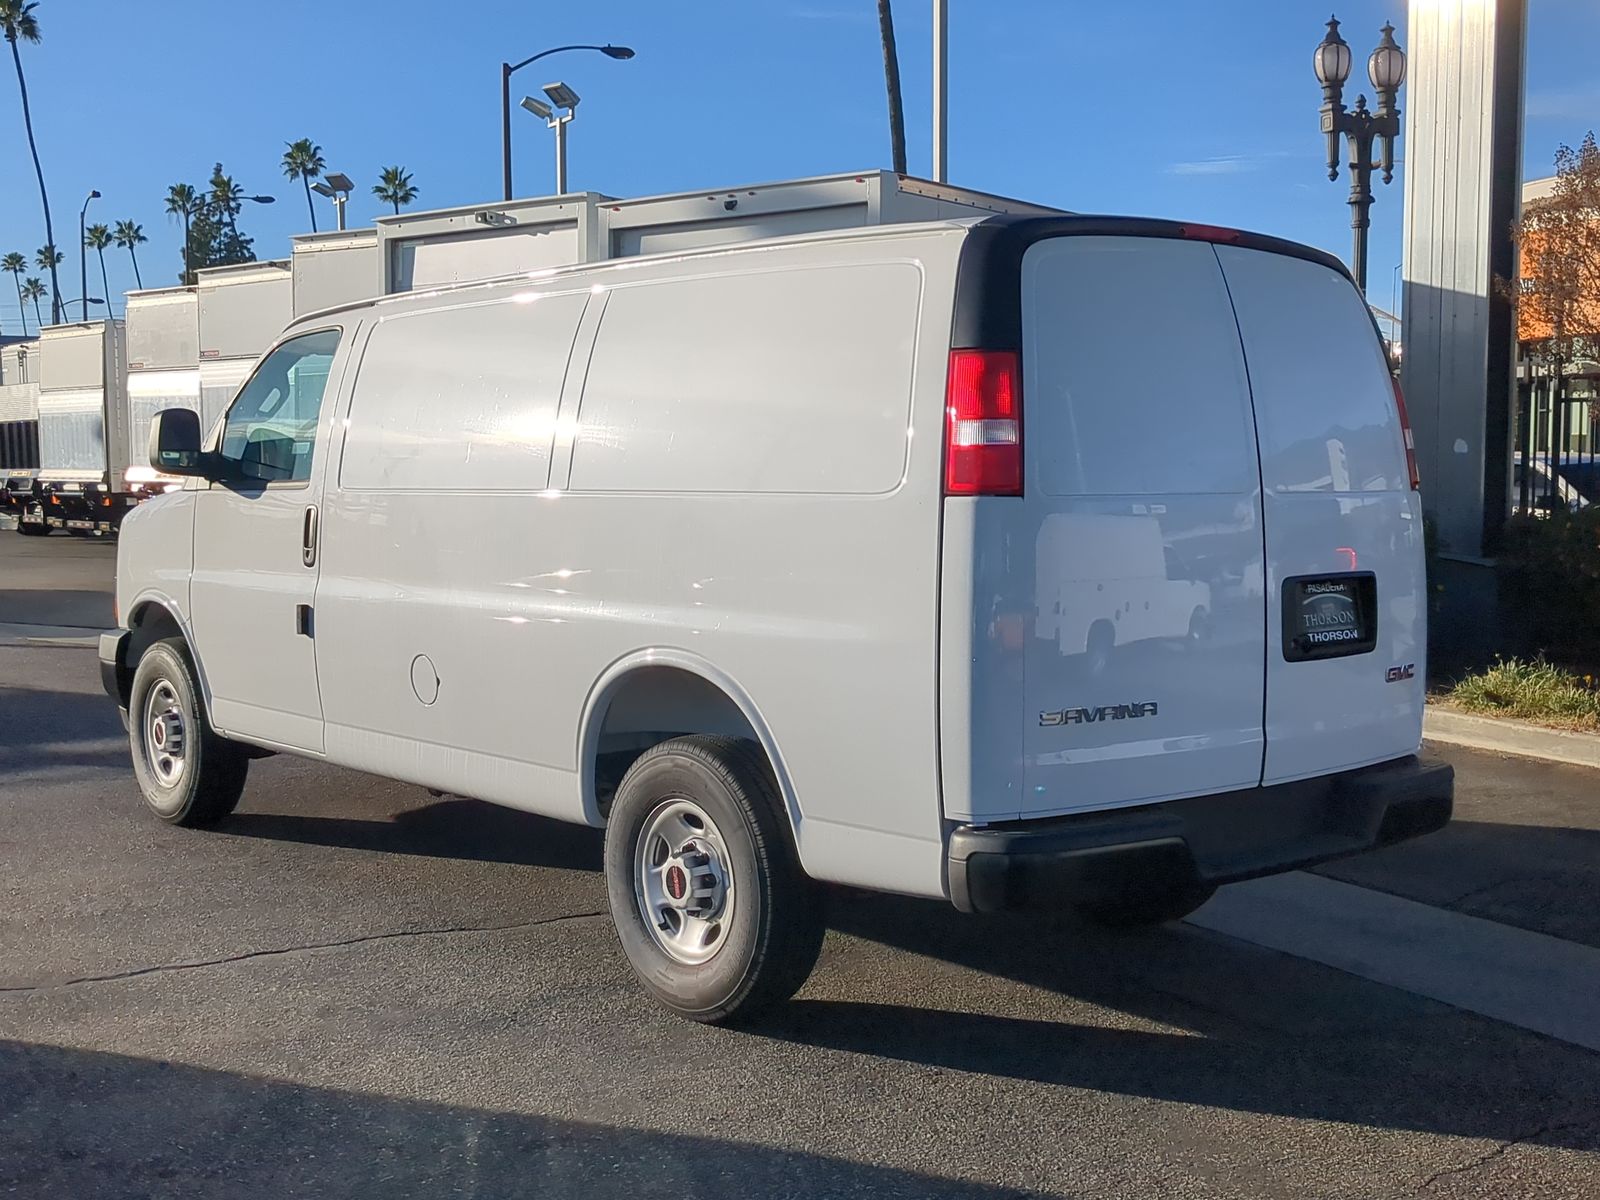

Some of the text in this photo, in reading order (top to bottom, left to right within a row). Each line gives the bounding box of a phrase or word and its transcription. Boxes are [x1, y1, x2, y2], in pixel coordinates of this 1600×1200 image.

[1303, 611, 1355, 626] THORSON
[1307, 629, 1358, 642] THORSON
[1386, 664, 1414, 682] GMC
[1039, 700, 1158, 726] SAVANA
